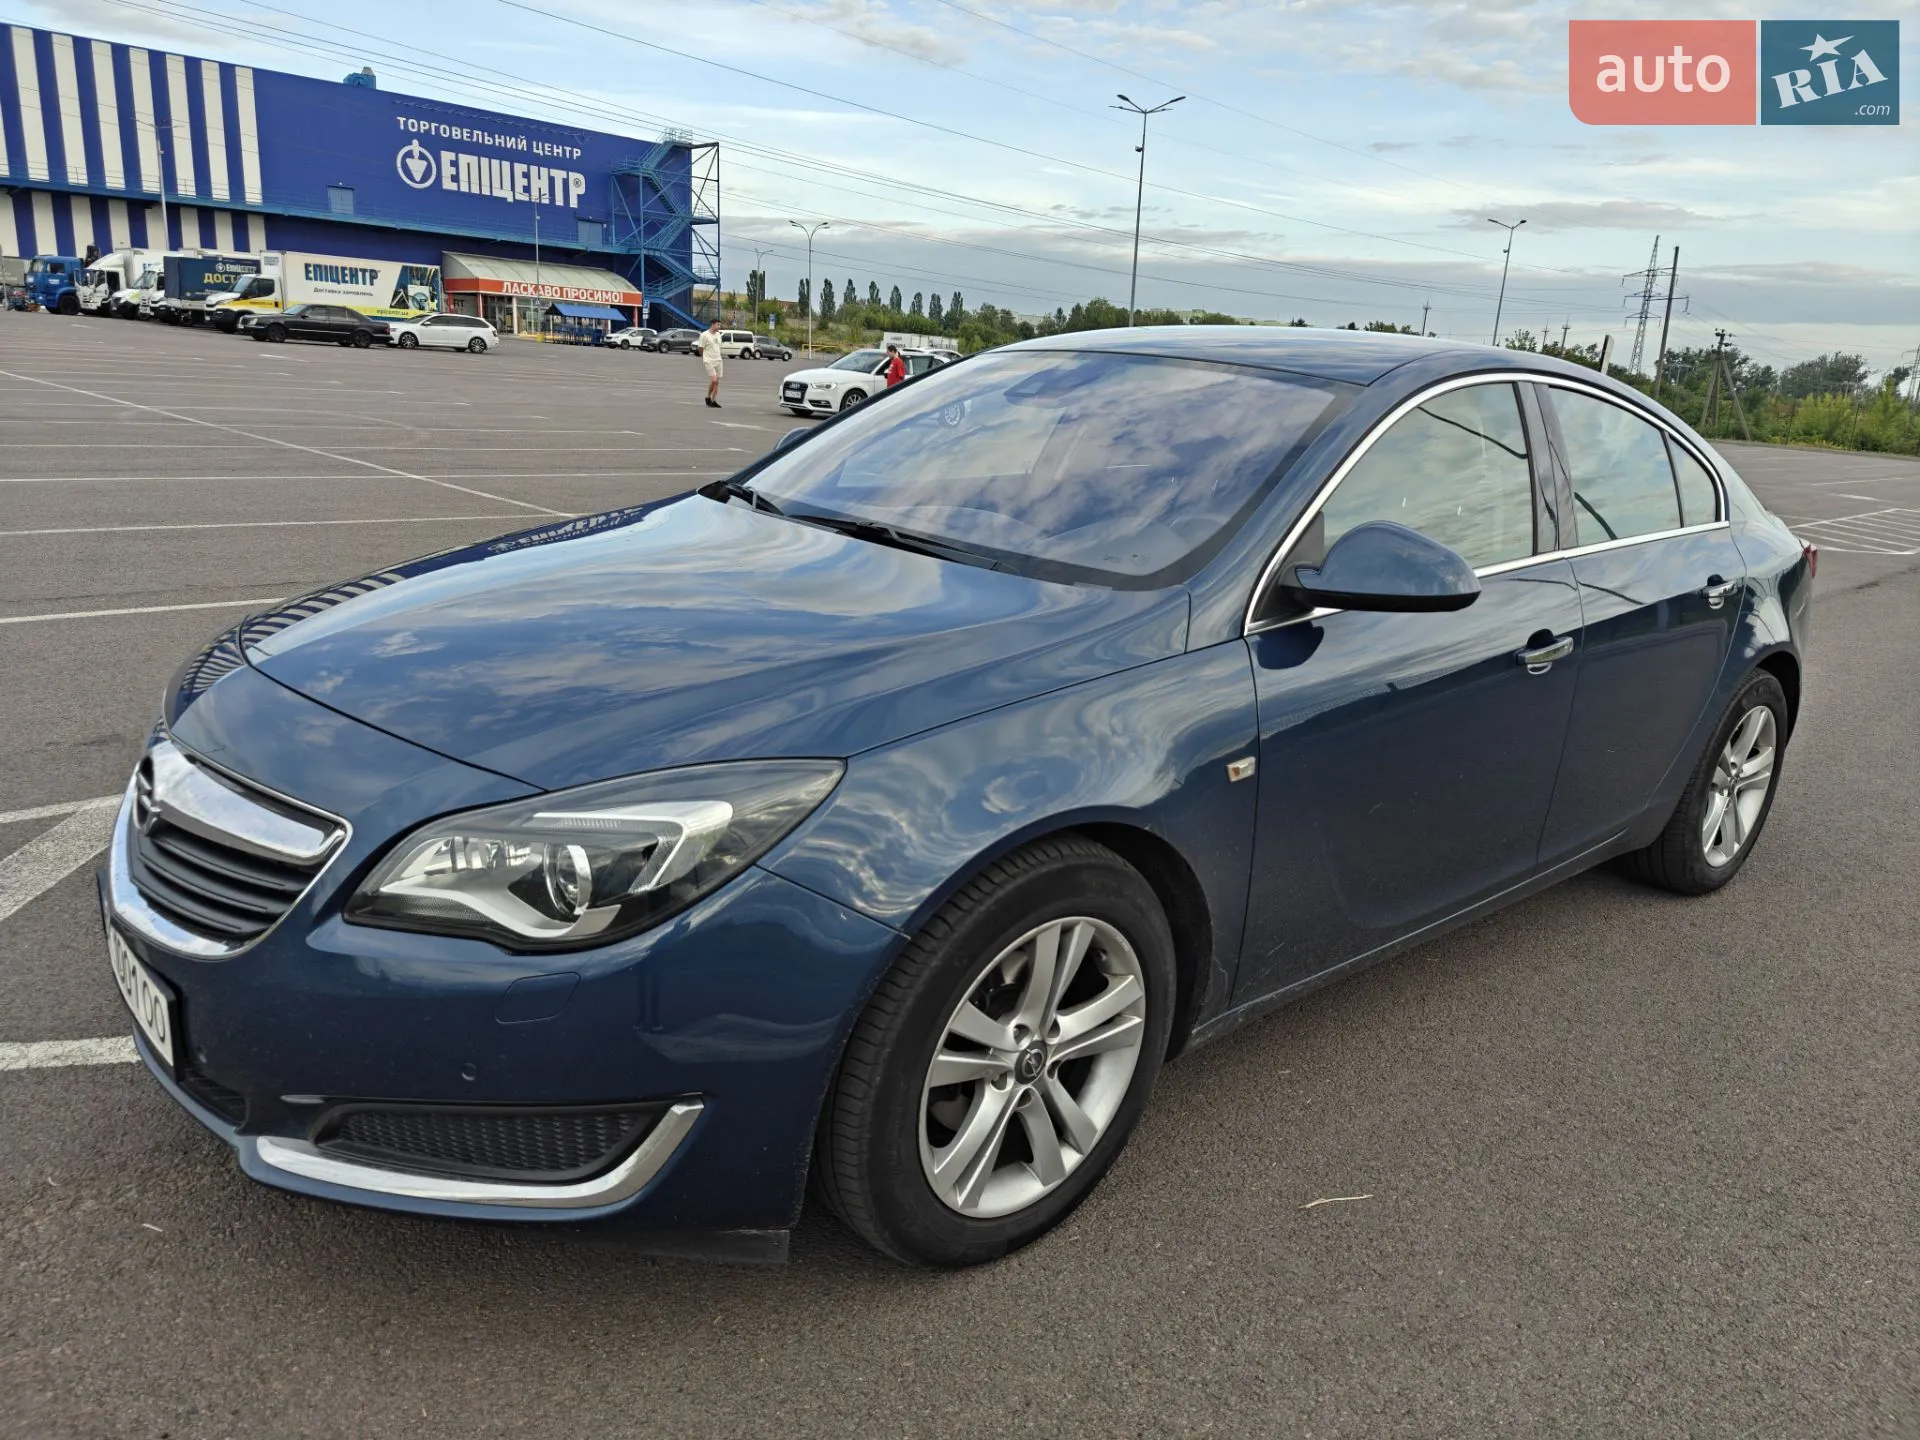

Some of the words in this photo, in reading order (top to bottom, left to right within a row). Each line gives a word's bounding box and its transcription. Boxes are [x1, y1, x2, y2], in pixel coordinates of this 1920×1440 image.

[396, 116, 527, 151] ТОРГОВЕЛЬНИЙ
[532, 140, 582, 160] ЦЕНТР
[440, 150, 586, 208] ЕПІЦЕНТР
[203, 272, 237, 284] ДОСТ
[304, 262, 379, 286] ЕПІЦЕНТР
[502, 281, 561, 298] ЛАСКАВО
[562, 287, 624, 303] ПРОСИМО!
